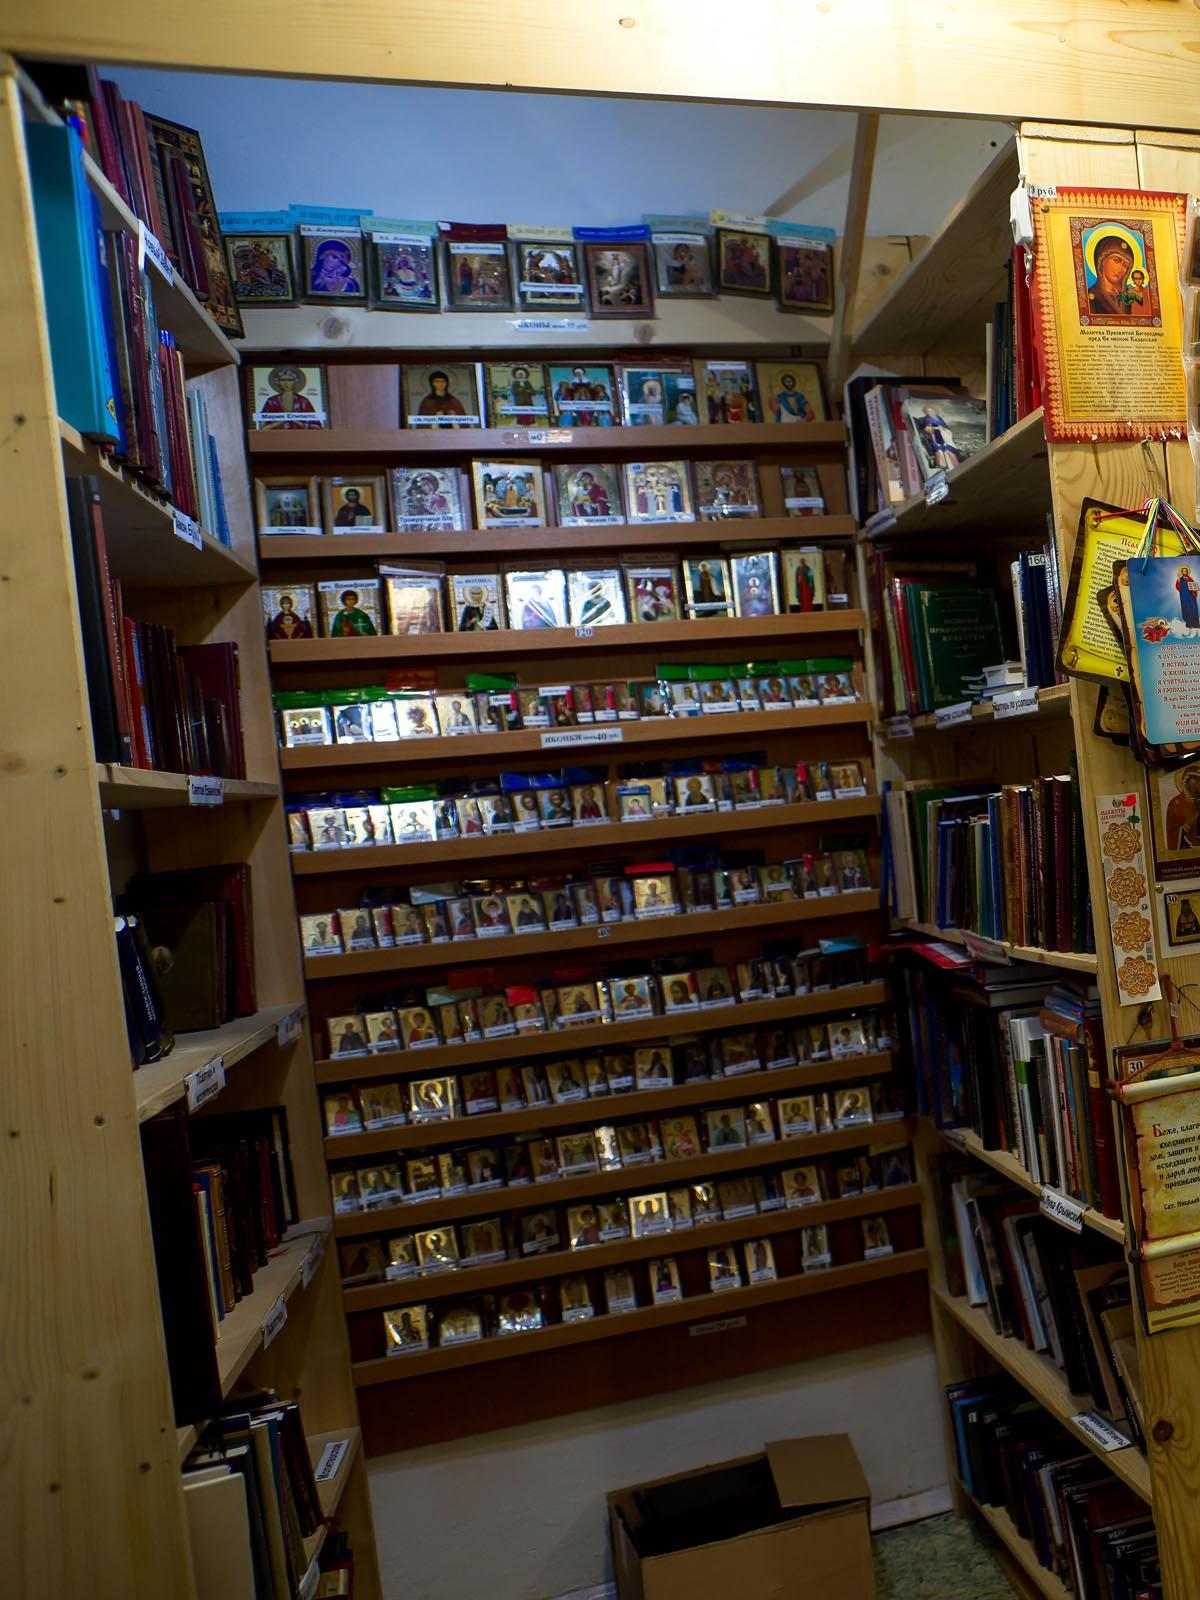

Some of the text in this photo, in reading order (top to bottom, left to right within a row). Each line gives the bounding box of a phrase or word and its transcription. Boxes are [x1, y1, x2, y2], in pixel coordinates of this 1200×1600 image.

[1029, 555, 1046, 565] 160
[1129, 1061, 1143, 1073] 30
[1167, 1146, 1193, 1158] защити
